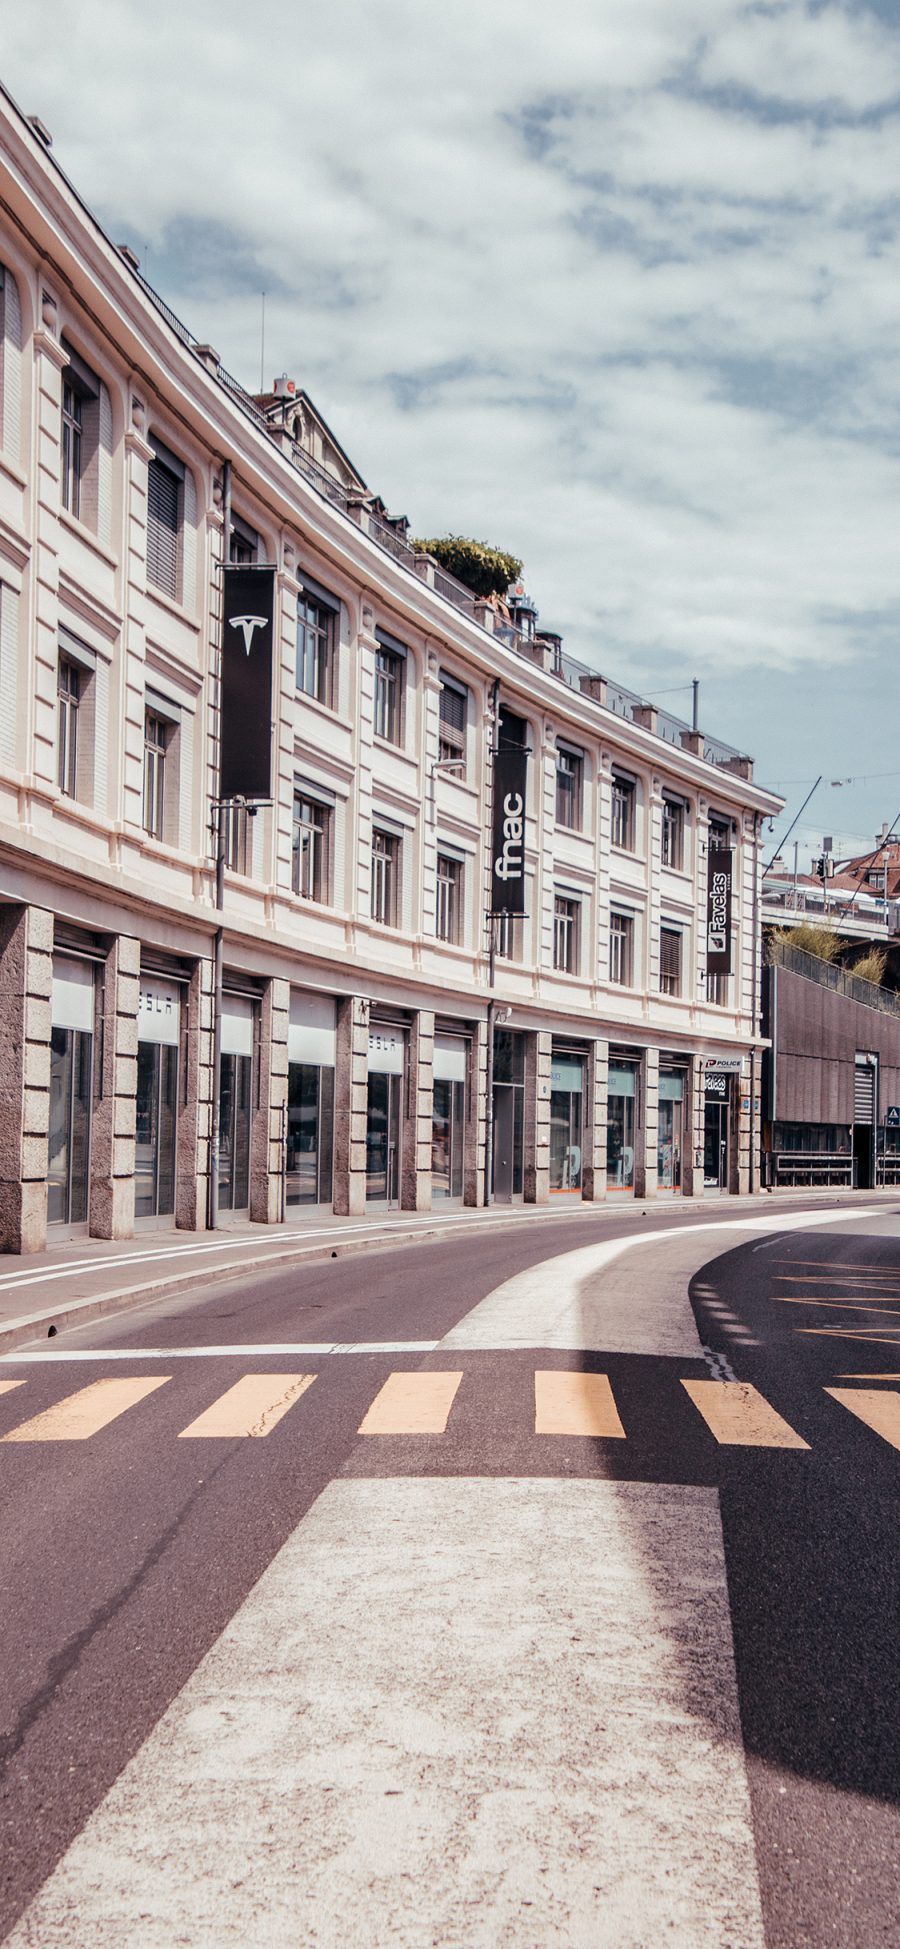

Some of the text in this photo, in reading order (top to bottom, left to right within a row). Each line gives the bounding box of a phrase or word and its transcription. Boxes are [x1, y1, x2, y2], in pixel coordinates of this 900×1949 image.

[494, 792, 524, 881] fnac
[709, 872, 727, 935] Favelas
[139, 991, 172, 1014] ESLA
